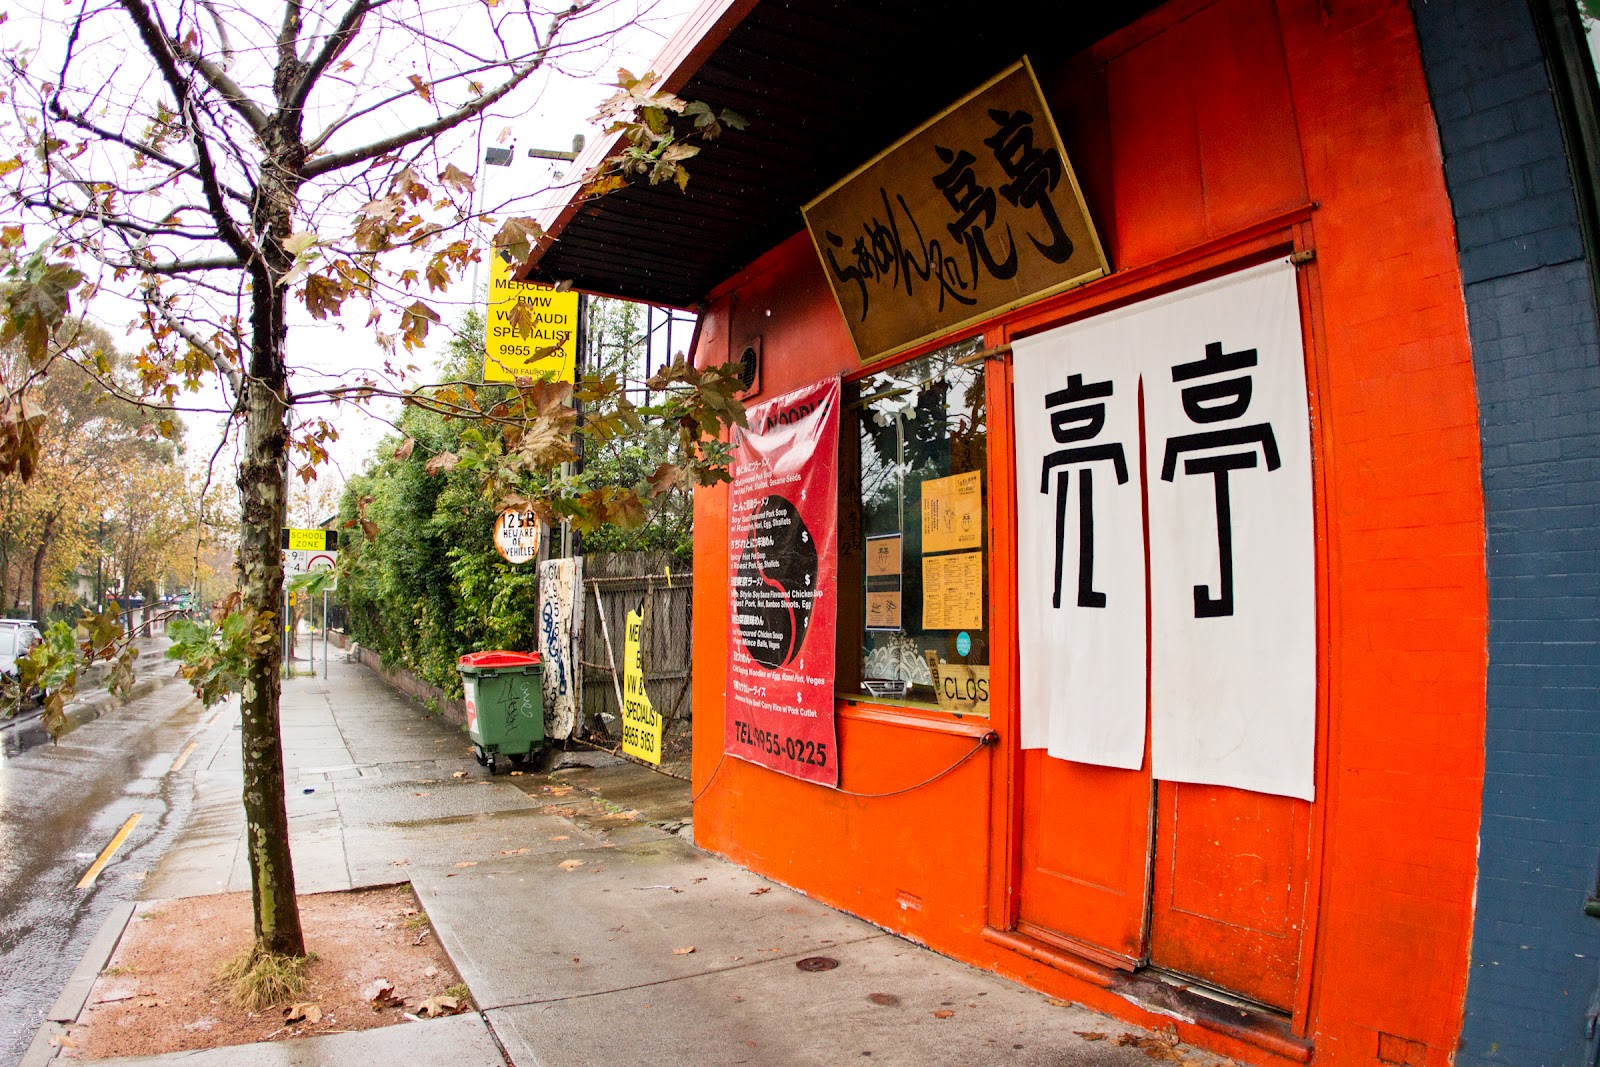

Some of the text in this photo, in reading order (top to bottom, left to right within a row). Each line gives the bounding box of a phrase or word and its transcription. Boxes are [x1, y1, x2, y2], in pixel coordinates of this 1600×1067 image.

[535, 312, 567, 325] AUDI
[493, 326, 573, 341] SPEIALIST
[499, 344, 531, 356] 9955
[785, 473, 802, 482] Seeds
[801, 489, 807, 501] $
[775, 508, 788, 517] Soup
[291, 532, 324, 540] SCHOOL
[801, 530, 809, 544] $
[295, 540, 319, 548] ZONE
[504, 546, 535, 557] VEHICLES
[804, 573, 811, 587] $
[791, 589, 813, 599] Chicken
[803, 616, 809, 628] $
[799, 658, 805, 671] $
[627, 674, 638, 695] VW
[805, 676, 825, 687] Veges
[796, 691, 803, 704] $
[625, 699, 658, 728] SPECIALIST
[799, 708, 818, 718] Cutlet
[624, 725, 655, 753] 9955 5153
